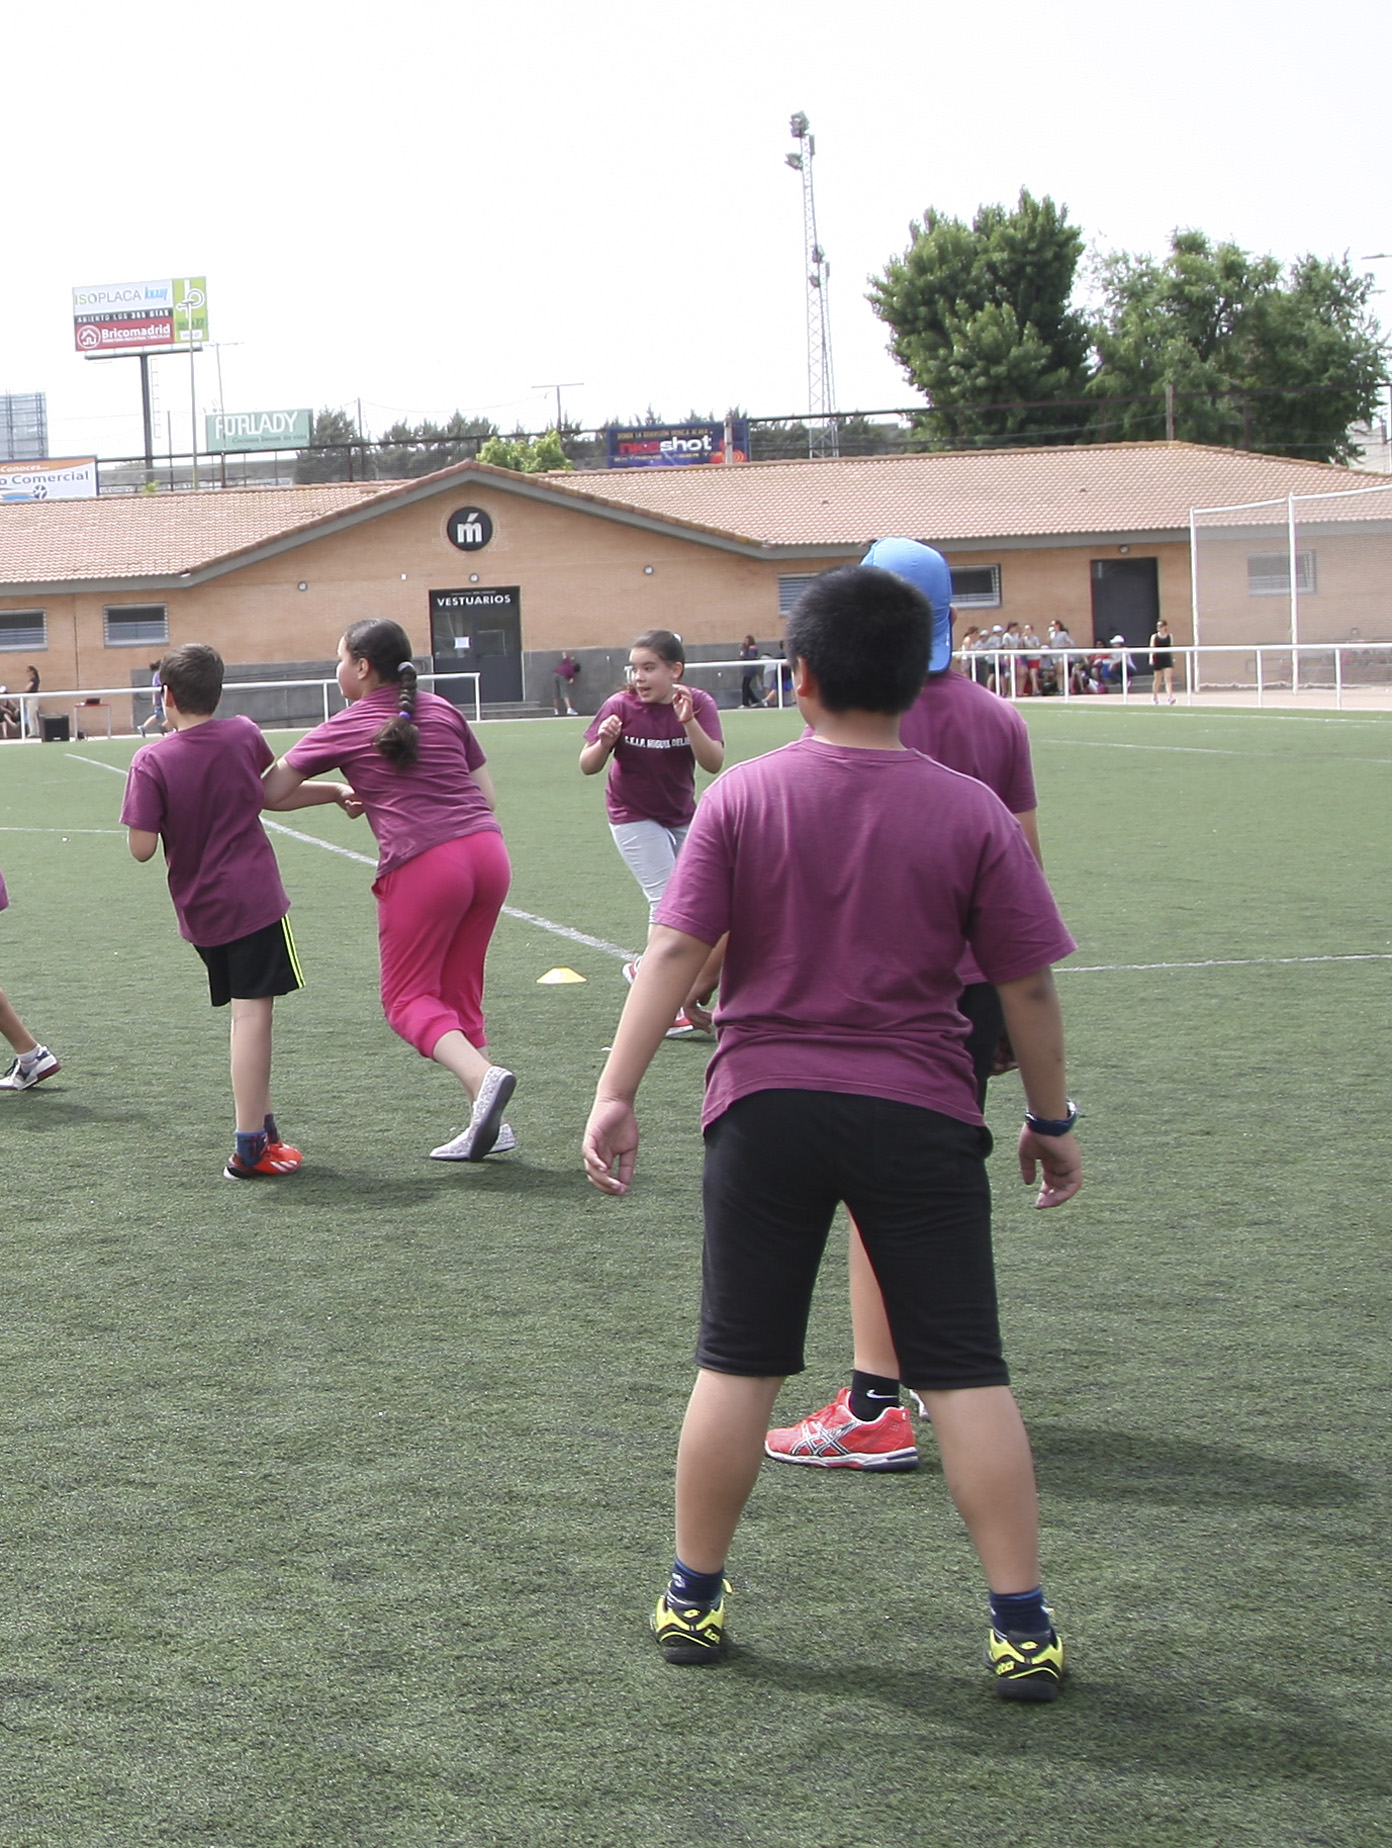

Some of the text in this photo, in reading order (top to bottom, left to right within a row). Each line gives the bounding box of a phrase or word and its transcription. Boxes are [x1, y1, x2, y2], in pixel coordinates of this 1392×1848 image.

[75, 289, 142, 305] ISOPLACA
[101, 323, 171, 339] Bricomadrid
[12, 470, 89, 485] Comercial
[437, 594, 511, 607] VESTUARIOS
